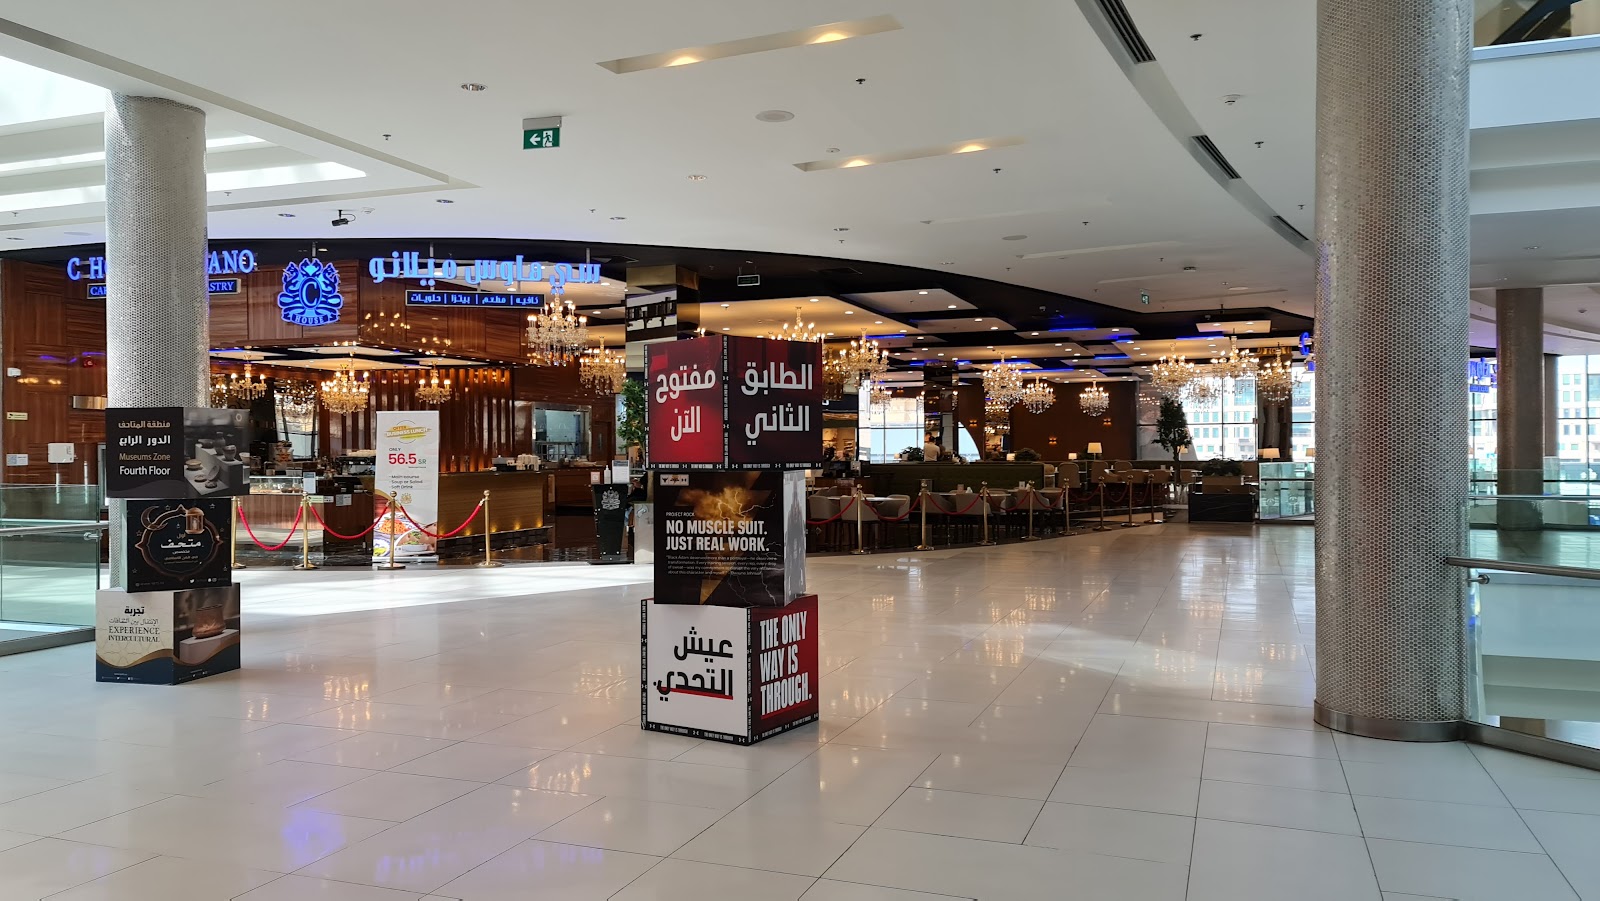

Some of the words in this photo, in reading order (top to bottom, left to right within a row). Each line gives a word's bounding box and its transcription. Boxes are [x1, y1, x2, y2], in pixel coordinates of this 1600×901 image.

[67, 257, 80, 280] C
[208, 249, 254, 273] ANO
[368, 251, 457, 286] ميلانو
[465, 255, 542, 286] هاوس
[549, 262, 601, 295] سي
[208, 281, 234, 292] STRY
[410, 293, 442, 304] حلويات
[451, 294, 470, 304] بيتزا
[482, 296, 507, 304] مطعم
[295, 316, 324, 325] HOUSE
[656, 364, 716, 404] مفتوح
[741, 362, 812, 396] الطابق
[118, 420, 146, 429] المتاحف
[146, 420, 170, 428] منطقة
[670, 406, 700, 442] الآن
[745, 403, 810, 446] الثاني
[119, 435, 142, 446] الرابع
[146, 435, 170, 446] الدور
[119, 452, 152, 460] Museums
[152, 452, 170, 460] Zone
[388, 453, 416, 464] 56.5
[120, 465, 148, 475] Fourth
[148, 465, 170, 475] Floor
[666, 520, 684, 534] NO
[686, 520, 734, 535] MUSCLE
[738, 520, 768, 535] SUIT.
[160, 539, 201, 548] متحف
[666, 536, 694, 550] JUST
[696, 536, 725, 551] REAL
[727, 537, 769, 552] WORK.
[124, 605, 144, 616] تجربة
[109, 626, 160, 635] EXPERIENCE
[760, 618, 778, 650] THE
[782, 611, 807, 644] ONLY
[674, 626, 733, 663] عيش
[760, 648, 785, 683] WAY
[787, 644, 798, 674] IS
[761, 672, 812, 716] THROUGH.
